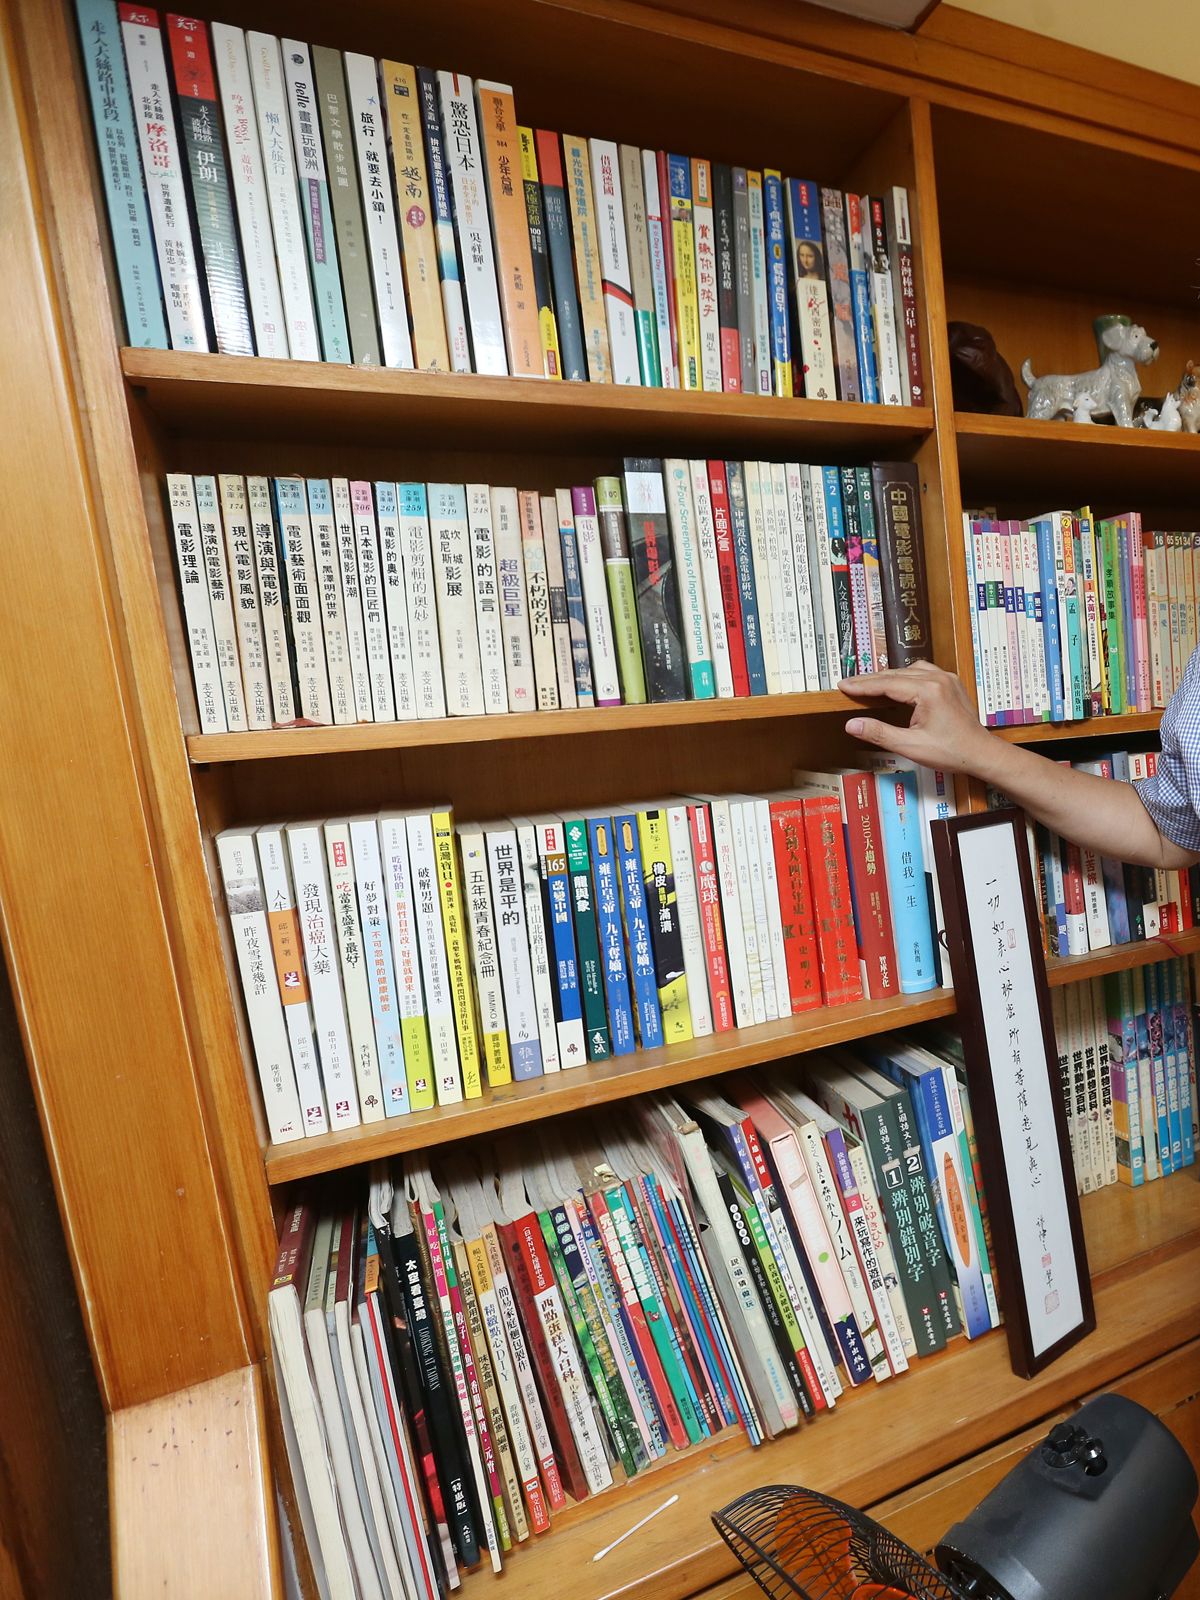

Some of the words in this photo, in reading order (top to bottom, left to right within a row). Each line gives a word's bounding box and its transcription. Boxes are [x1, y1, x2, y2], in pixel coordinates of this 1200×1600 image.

[145, 122, 171, 170] 摩洛哥
[197, 150, 219, 183] 伊朗
[450, 100, 477, 173] 驚恐日本
[177, 522, 200, 584] 電影理論
[202, 523, 225, 601] 導演的電影藝術
[339, 523, 359, 598] 世界電影新潮
[714, 507, 730, 552] 片面之言
[1155, 535, 1164, 545] 16
[232, 525, 256, 610] 現代電影風貌
[256, 522, 280, 607] 導演與電影
[286, 525, 312, 624] 電影藝術面面觀
[359, 525, 381, 624] 日本電影的巨匠們
[407, 525, 429, 623] 電影剪輯的奧妙
[444, 567, 464, 597] 影展
[473, 527, 496, 613] 電影的語言
[499, 559, 523, 617] 超級巨星
[890, 488, 922, 641] 中國電影電視名人錄
[364, 881, 381, 927] 好夢對策
[494, 844, 521, 926] 世界是平的
[699, 874, 719, 904] 魔球
[901, 850, 918, 909] 借我一生
[302, 883, 331, 975] 發現治癌大藥
[469, 870, 496, 979] 五年級青春紀念冊
[1072, 1050, 1087, 1116] 世界動物百科
[1084, 1046, 1099, 1112] 世界動物百科
[1098, 1044, 1113, 1108] 世界動物百科
[887, 1170, 899, 1186] 1
[906, 1156, 919, 1173] 2
[576, 1232, 591, 1266] Namo
